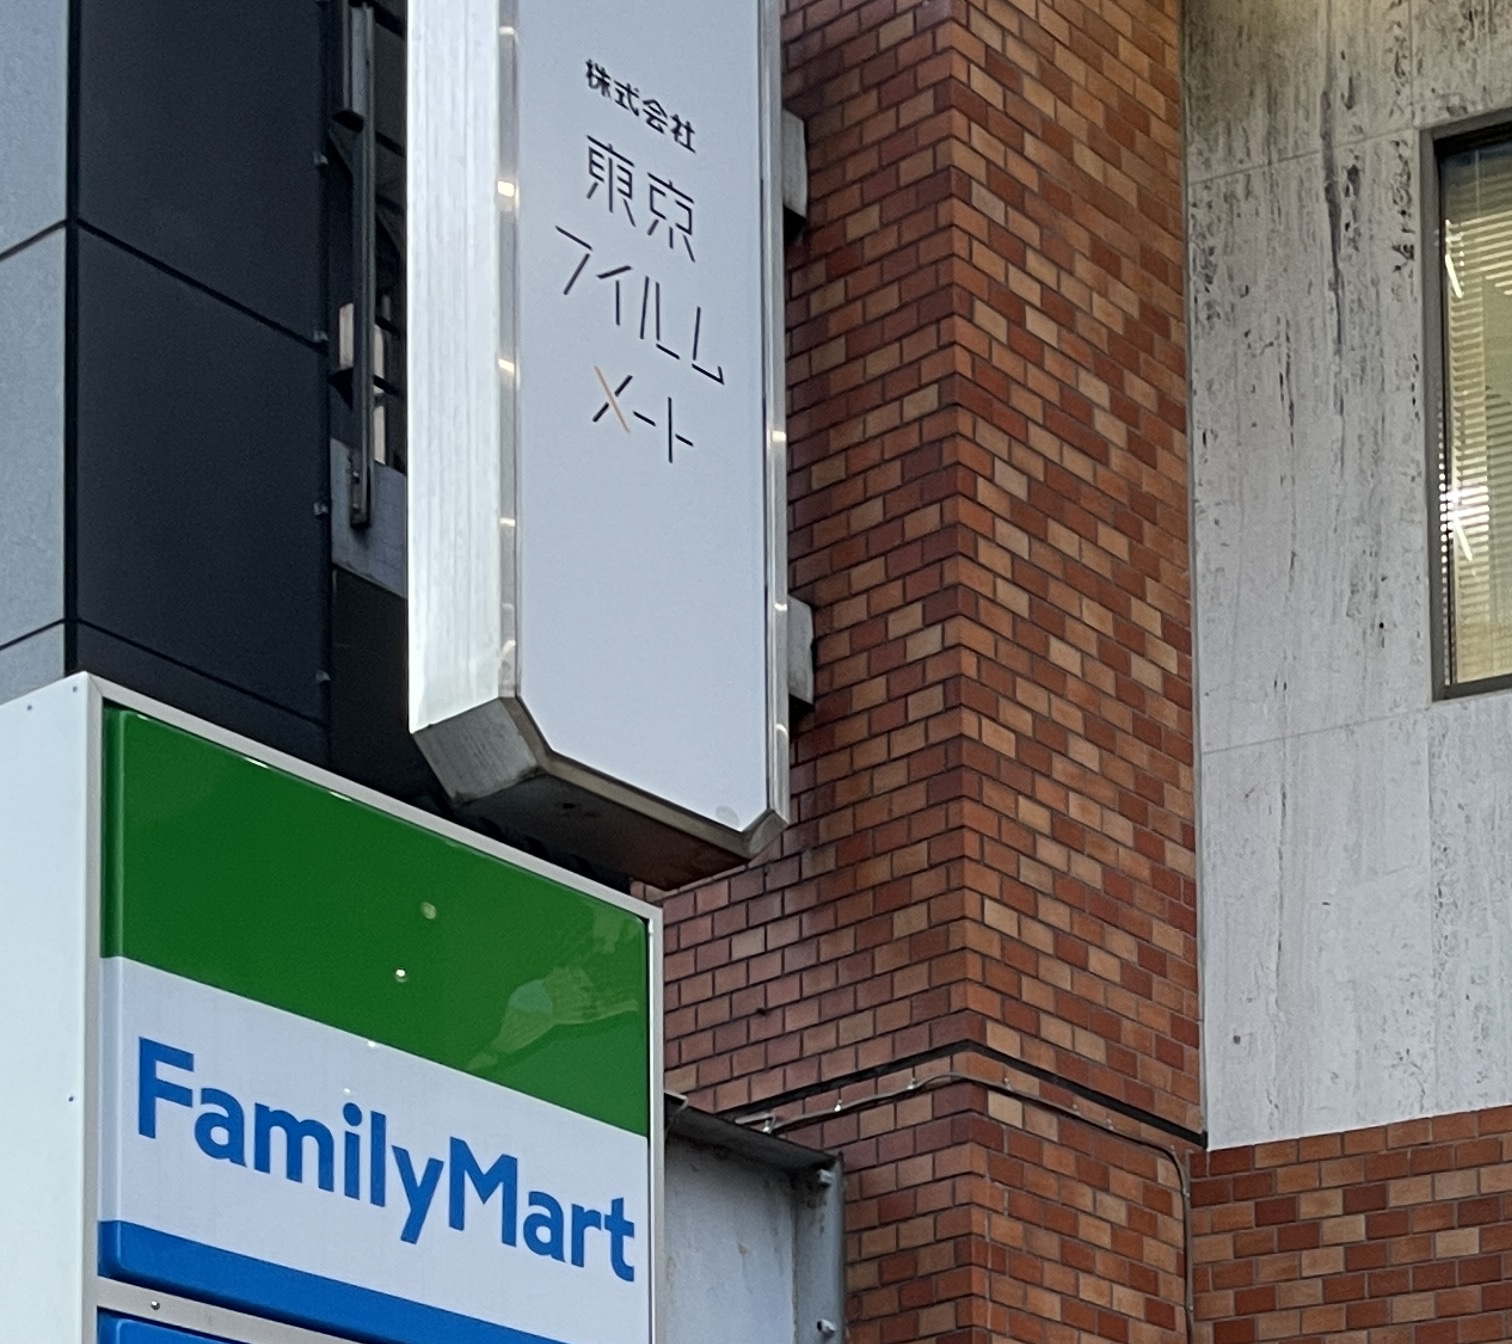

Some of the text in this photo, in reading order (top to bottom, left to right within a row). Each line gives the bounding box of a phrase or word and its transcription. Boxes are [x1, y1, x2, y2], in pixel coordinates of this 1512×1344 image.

[585, 58, 698, 154] 株式会社
[586, 133, 696, 264] 東京
[592, 364, 696, 465] メート
[137, 1036, 638, 1284] FamilyMart
